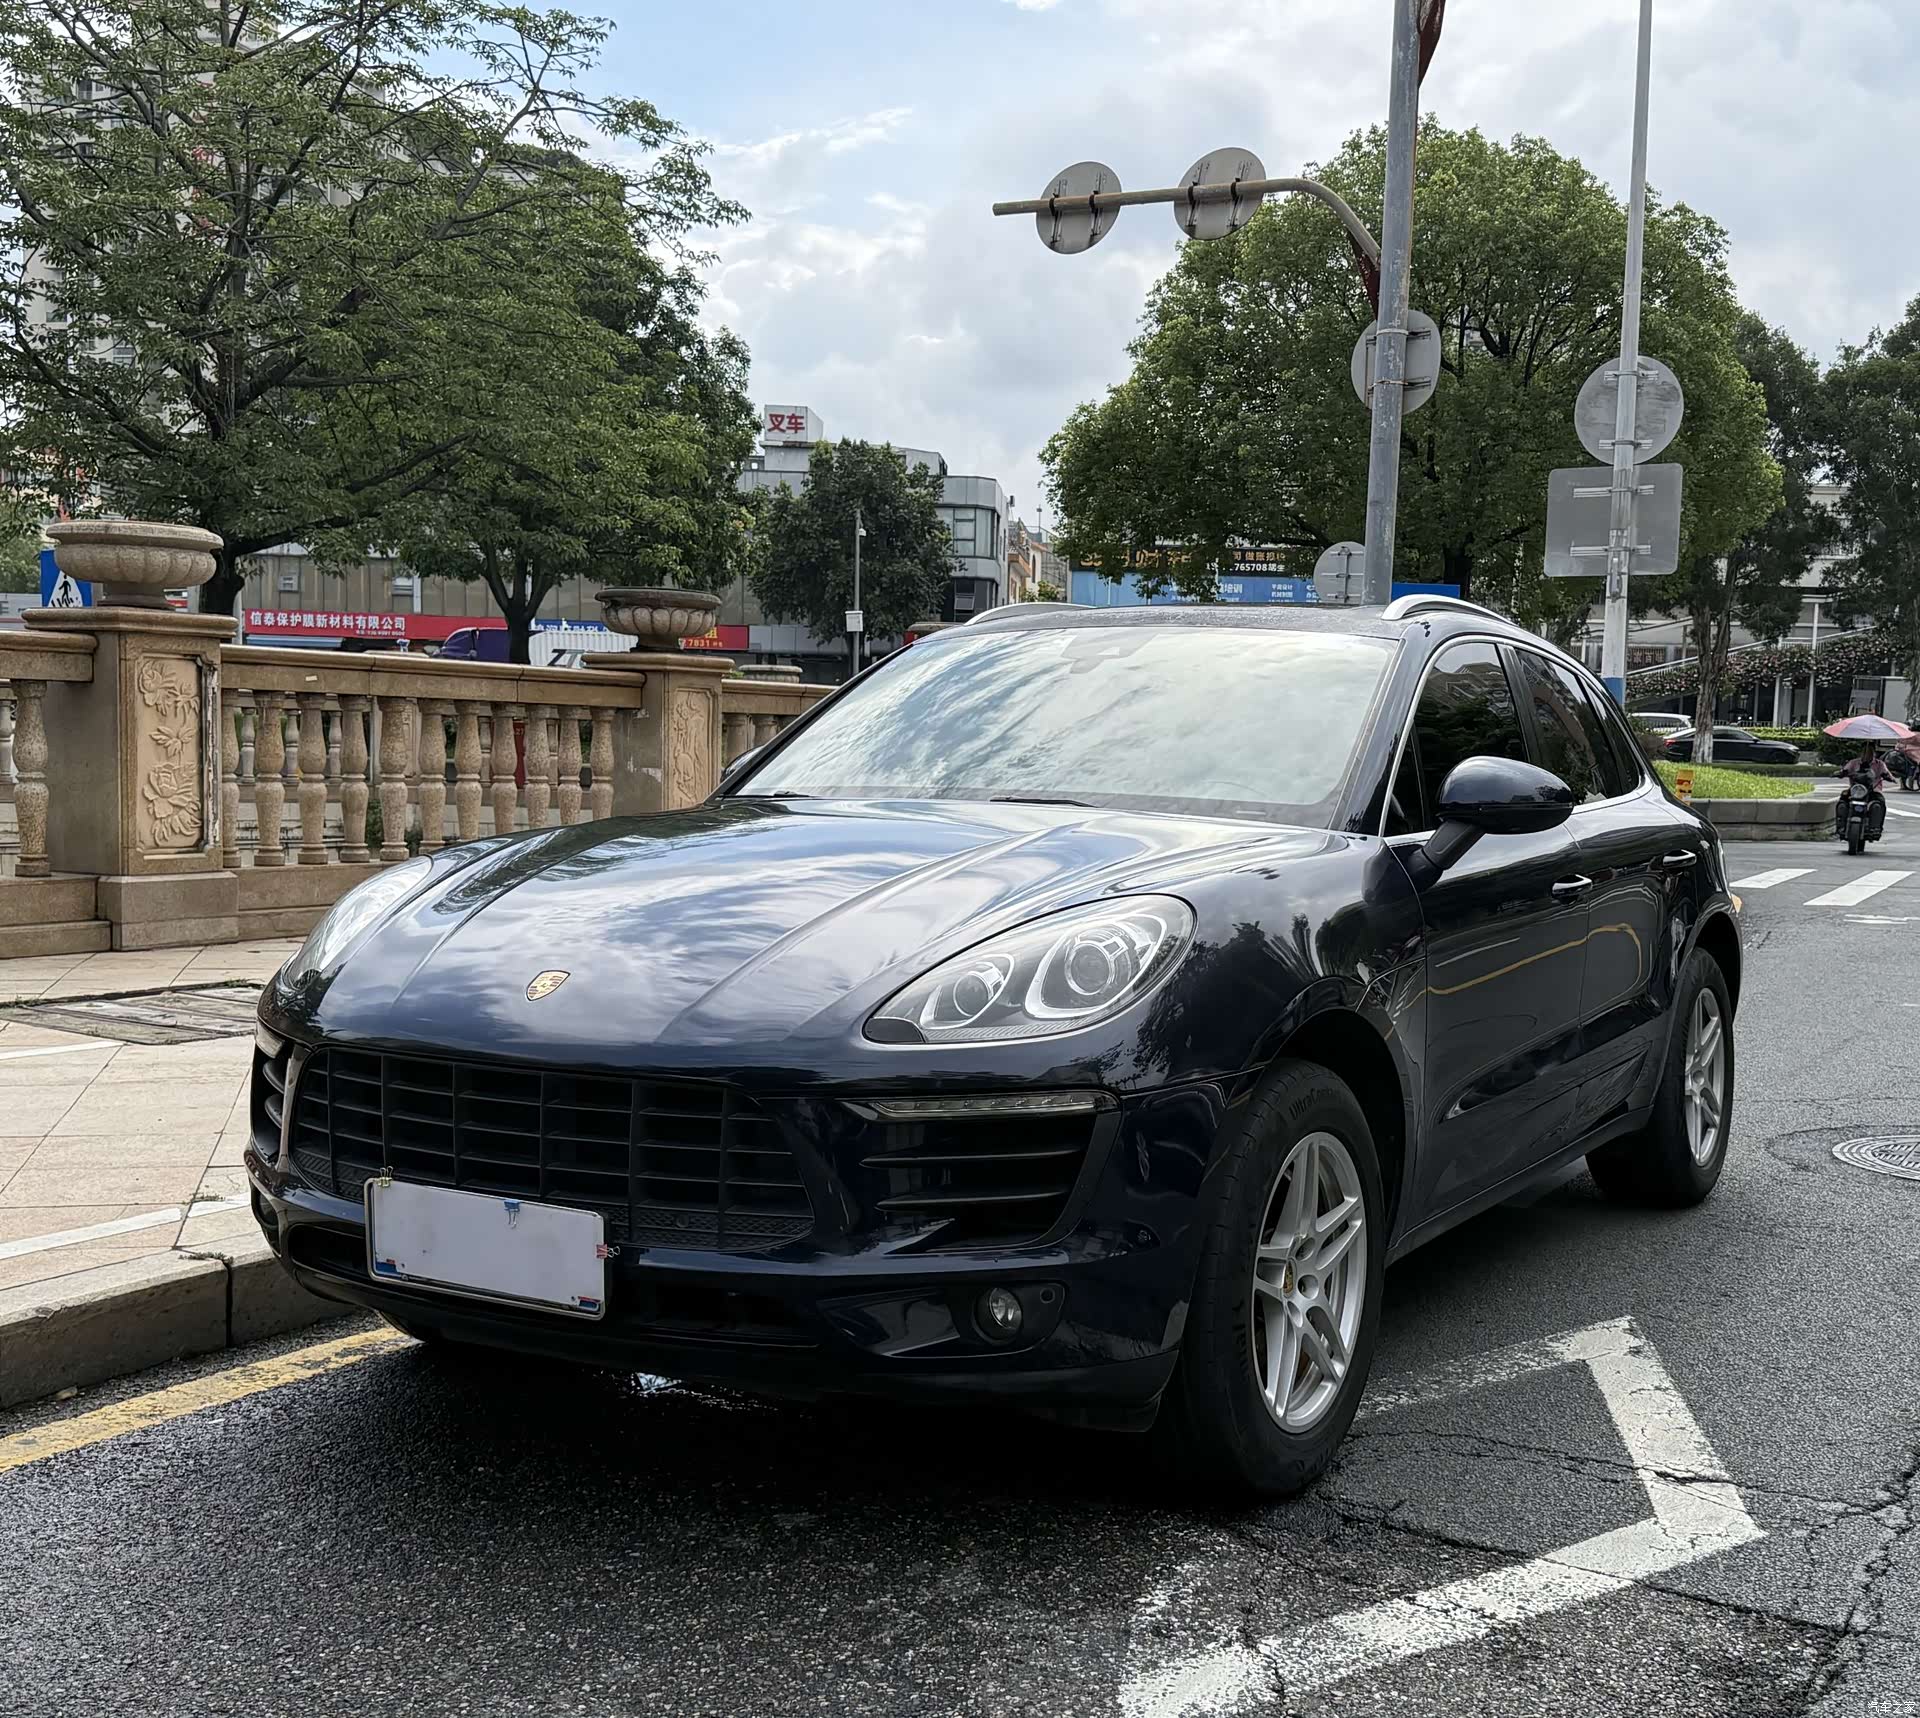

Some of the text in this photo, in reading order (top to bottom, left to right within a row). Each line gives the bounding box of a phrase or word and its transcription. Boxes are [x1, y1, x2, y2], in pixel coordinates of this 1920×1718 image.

[767, 413, 806, 434] 叉车
[251, 611, 405, 631] 信泰保护膜新材料有限公司
